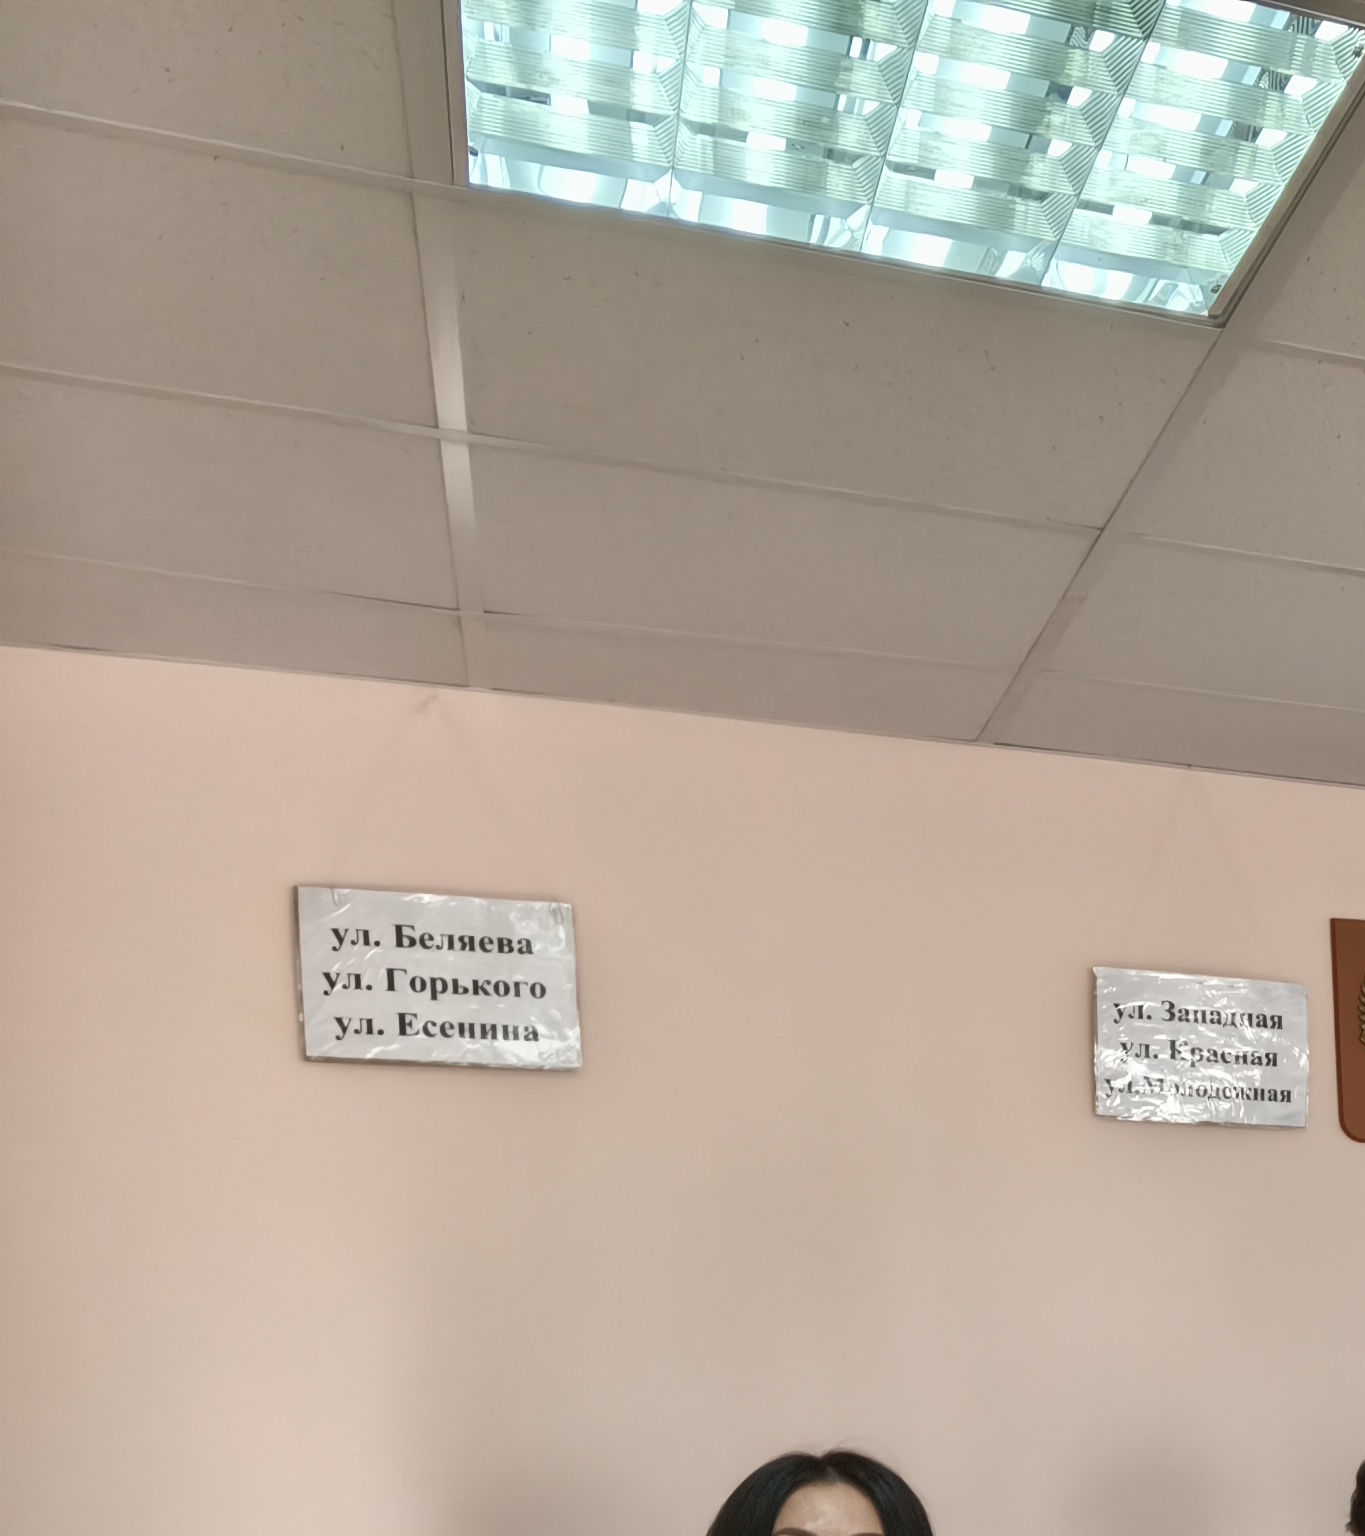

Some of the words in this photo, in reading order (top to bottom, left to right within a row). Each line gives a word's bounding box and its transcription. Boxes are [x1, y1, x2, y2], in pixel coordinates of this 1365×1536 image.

[330, 926, 382, 953] ул.
[394, 923, 535, 956] Беляева
[322, 970, 374, 997] ул.
[385, 967, 548, 1001] Горького
[334, 1015, 385, 1041] ул.
[397, 1012, 540, 1043] Есенина
[1113, 1002, 1153, 1025] ул.
[1119, 1041, 1159, 1064] ул.
[1167, 1039, 1279, 1068] Красная
